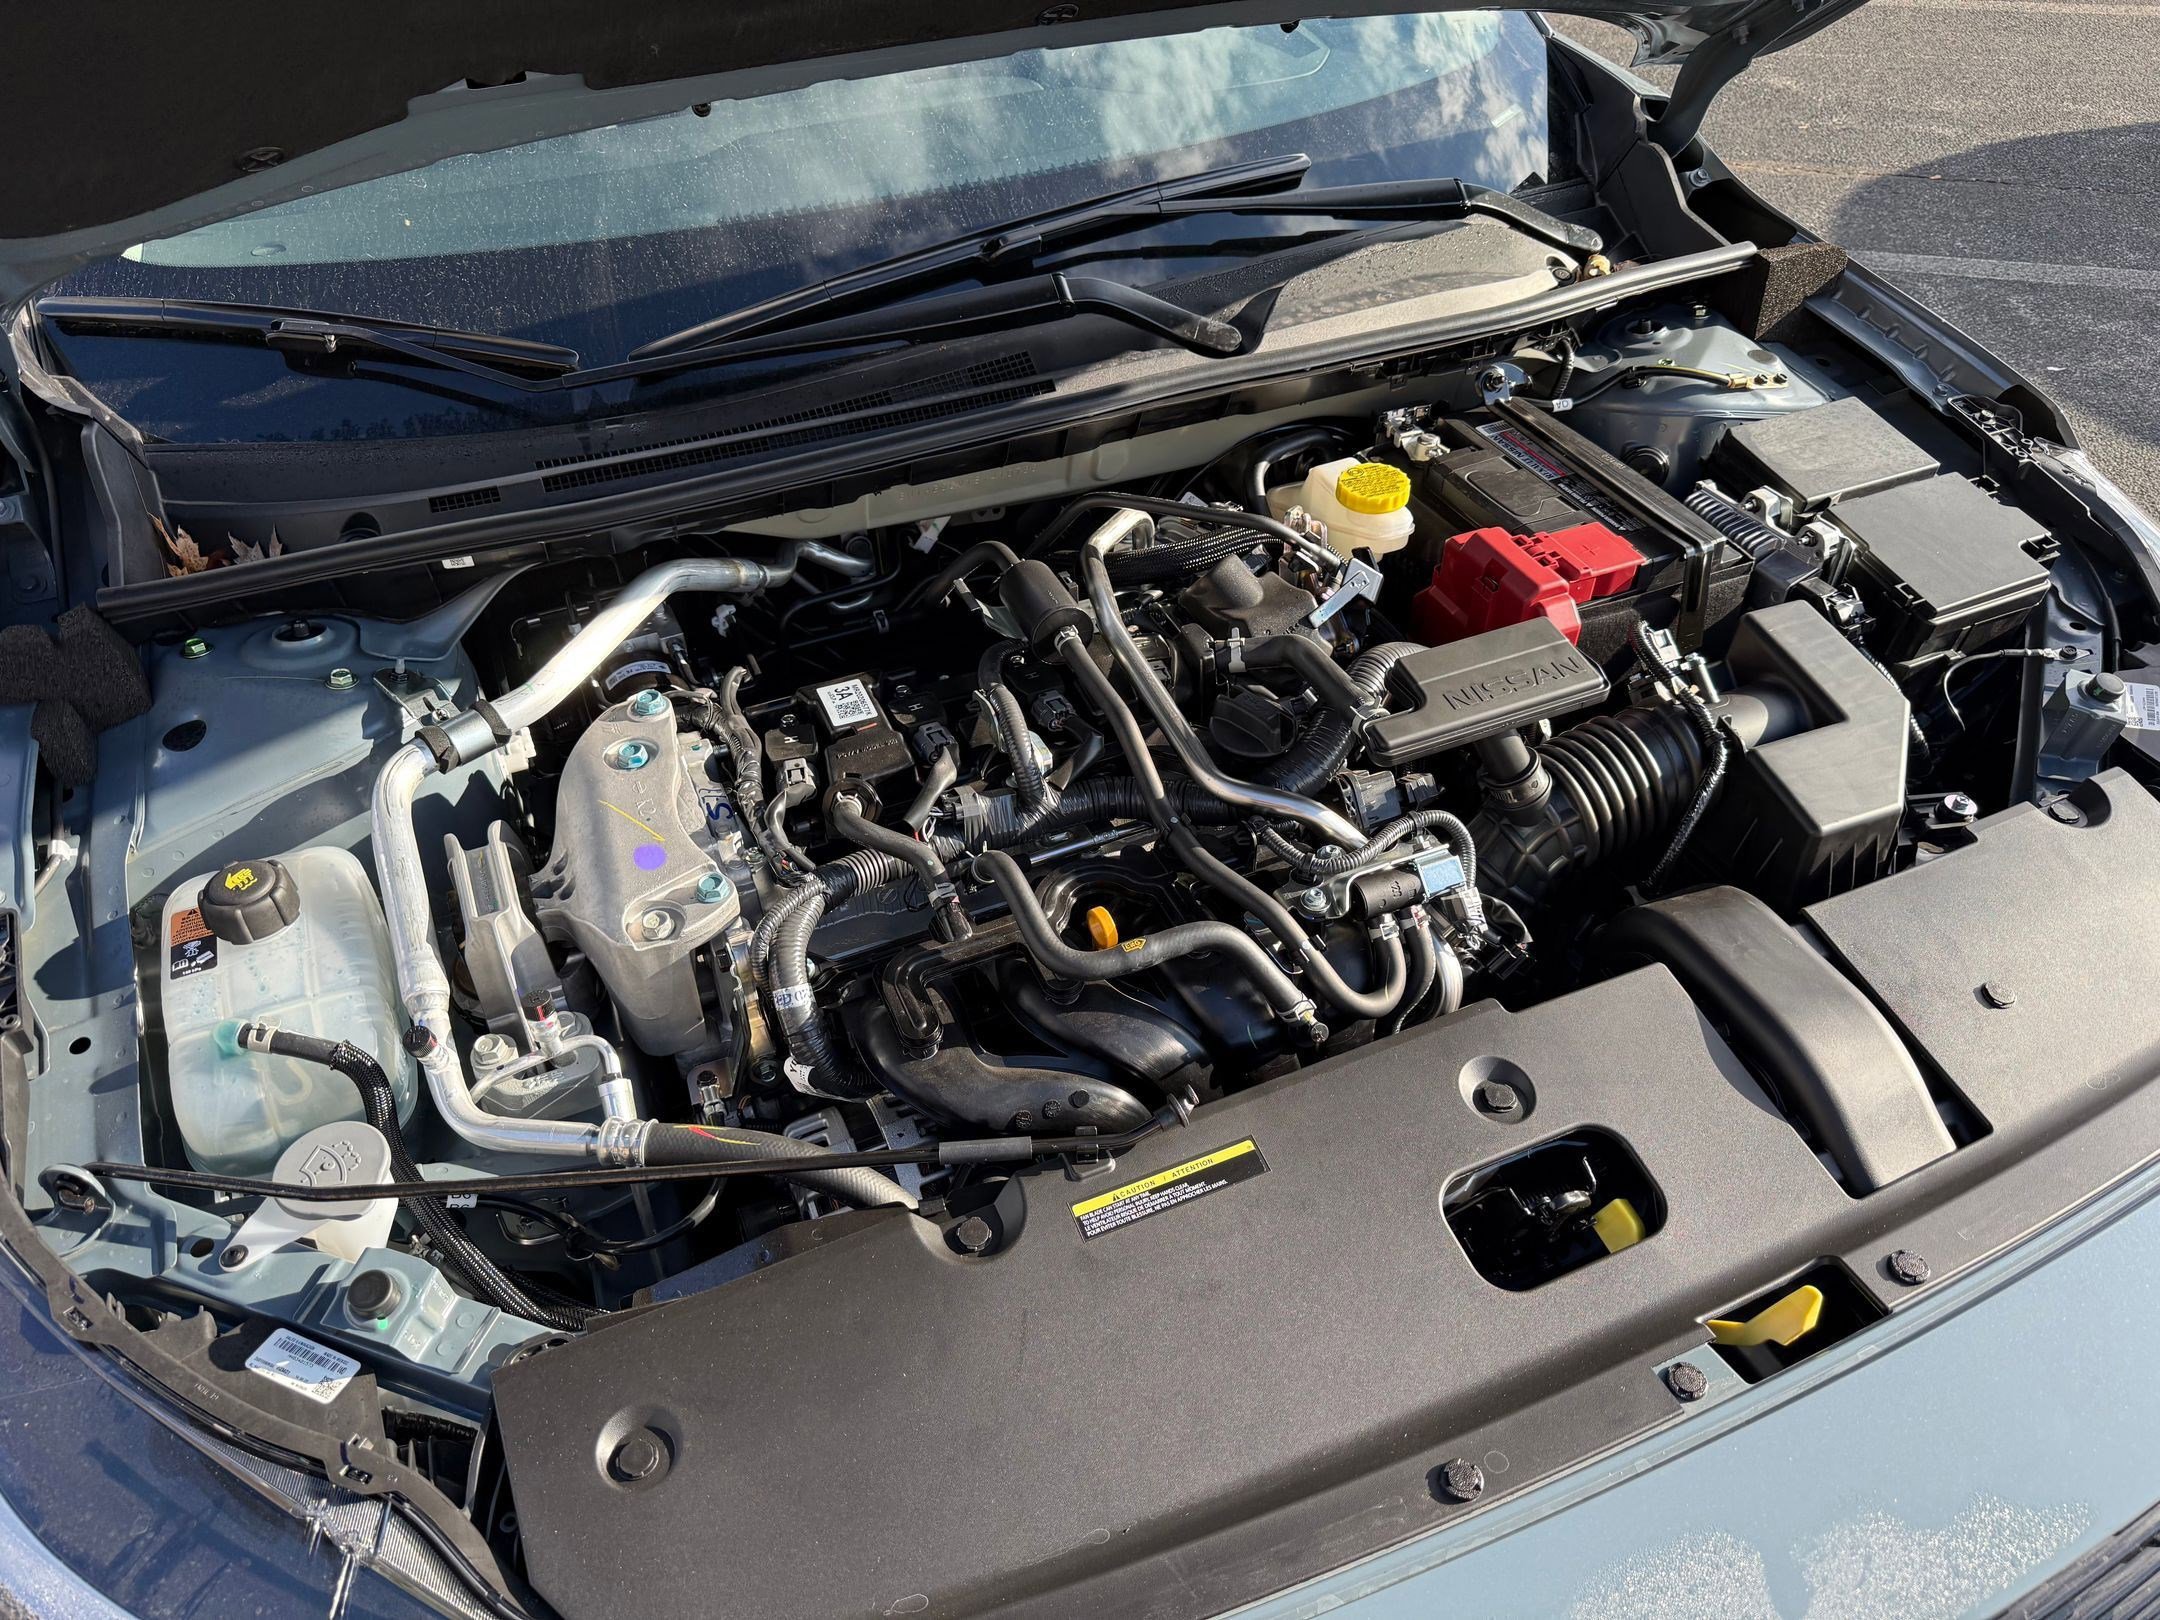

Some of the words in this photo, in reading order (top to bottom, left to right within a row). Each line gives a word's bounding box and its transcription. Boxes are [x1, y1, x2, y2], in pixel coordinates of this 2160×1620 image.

[1492, 435, 1524, 458] NISSAN
[834, 685, 854, 701] 3A
[1442, 656, 1587, 711] NISSAN
[1120, 1180, 1156, 1198] CAUTION
[1171, 1158, 1214, 1178] ATTENTION
